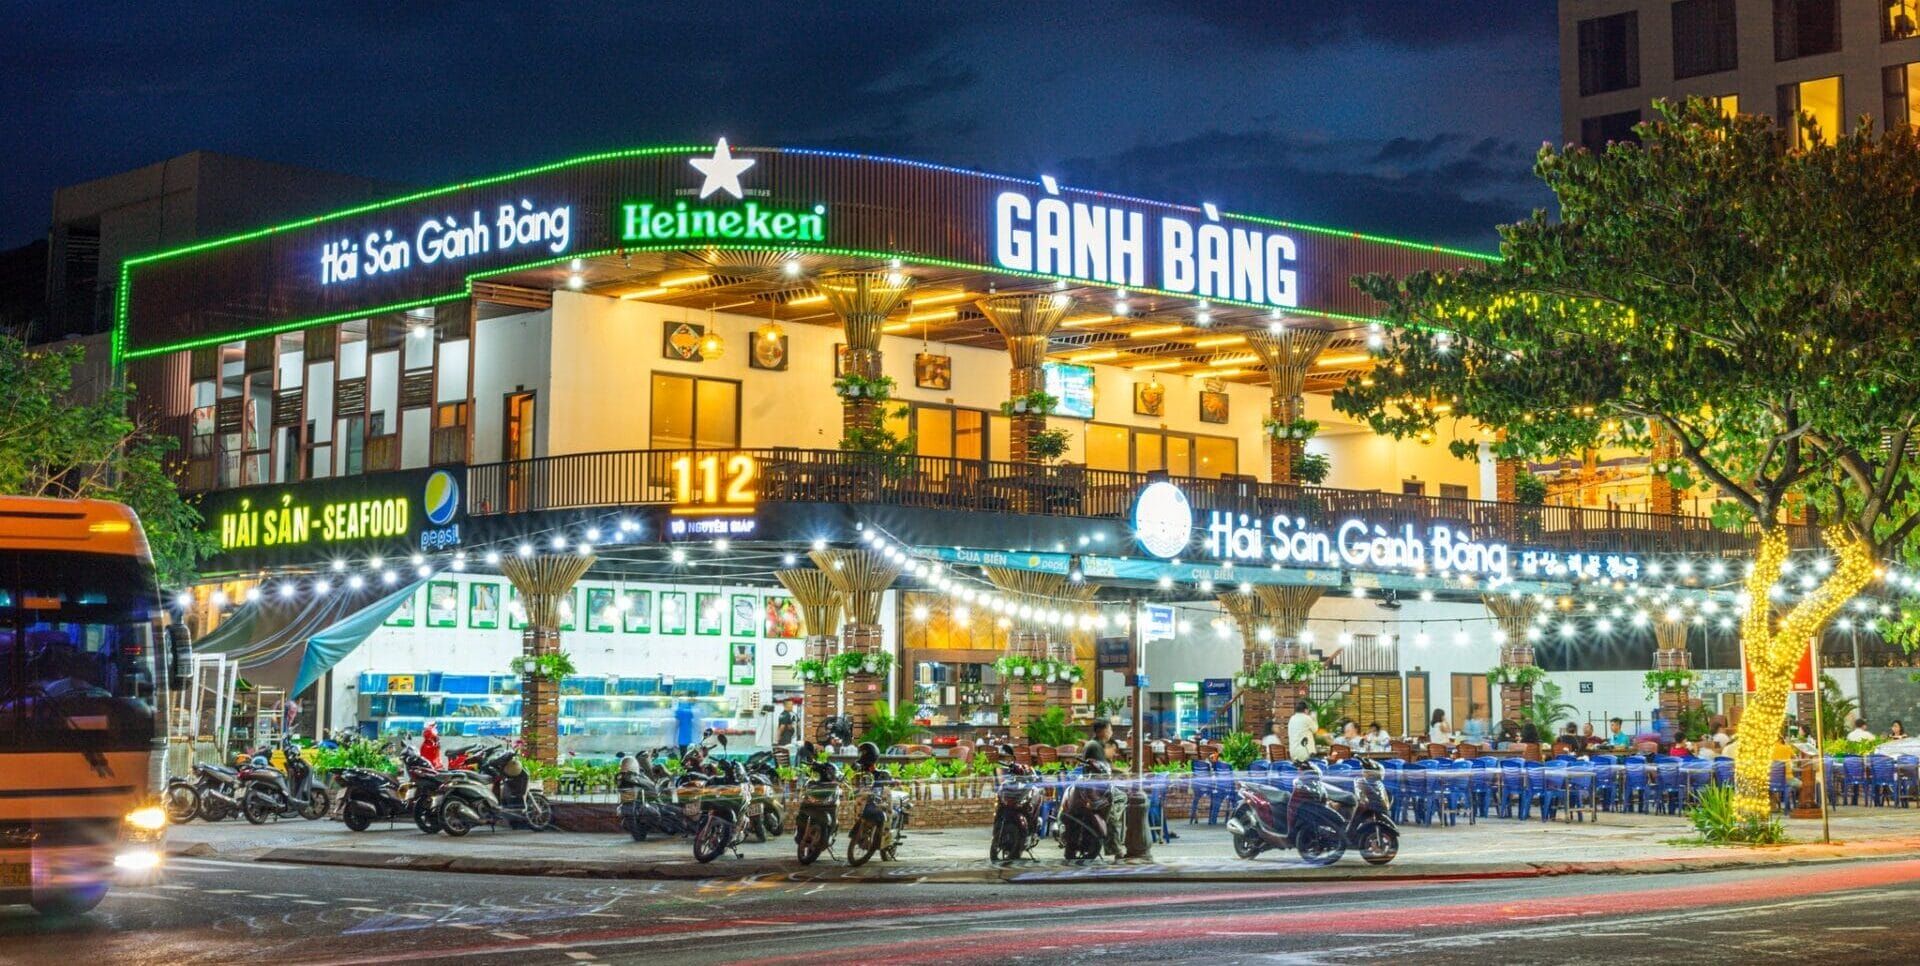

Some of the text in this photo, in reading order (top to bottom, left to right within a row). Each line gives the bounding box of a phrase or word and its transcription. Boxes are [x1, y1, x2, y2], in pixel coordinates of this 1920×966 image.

[321, 199, 570, 284] Hải Sản Gành Bàng
[622, 202, 825, 241] Heineken
[997, 175, 1297, 307] GÀNH BÀNG
[672, 455, 755, 503] 112
[222, 499, 258, 548] HẢI
[1209, 511, 1262, 558] Hải
[1338, 519, 1424, 568] Gành
[1430, 526, 1508, 586] Bàng
